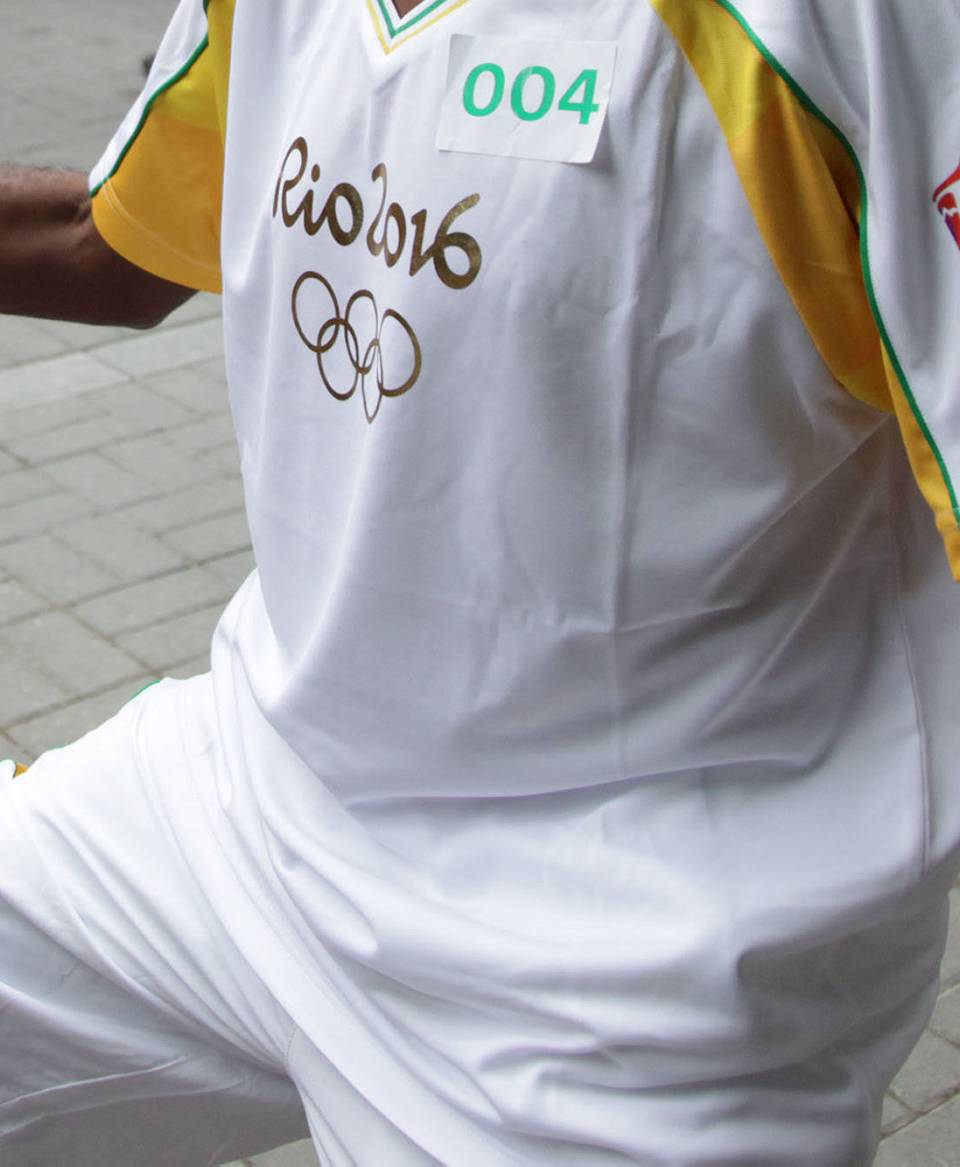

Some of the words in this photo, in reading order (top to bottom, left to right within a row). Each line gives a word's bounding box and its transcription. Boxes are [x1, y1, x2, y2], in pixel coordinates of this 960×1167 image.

[462, 62, 600, 125] 004
[273, 136, 364, 246] Rio
[367, 162, 482, 290] 2016
